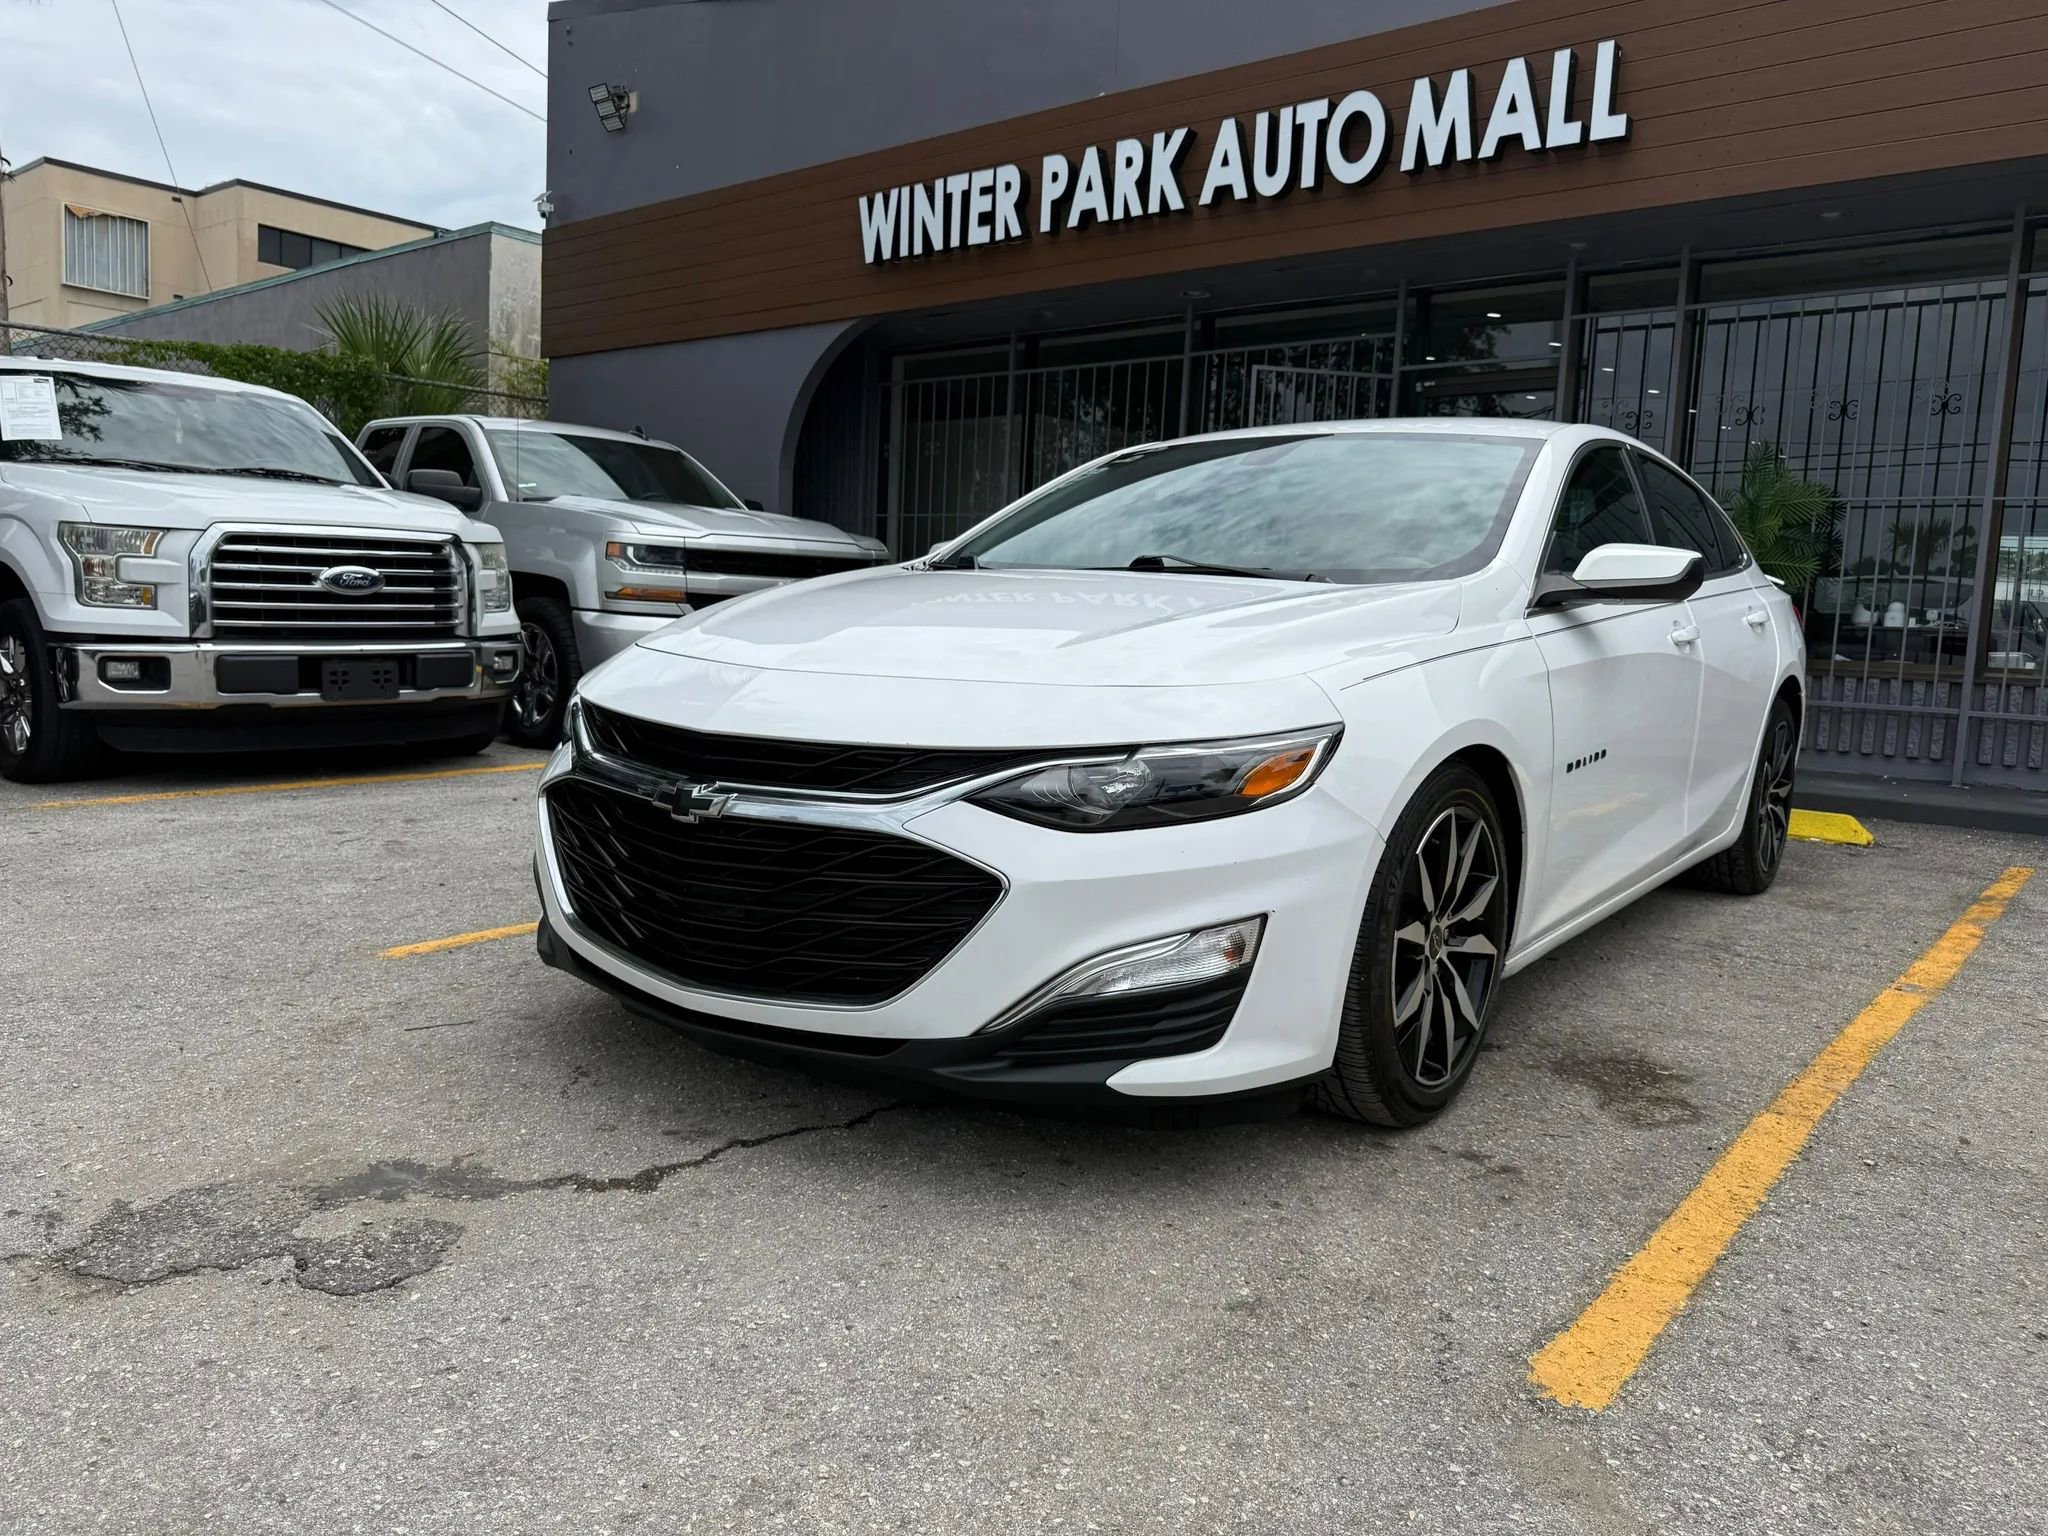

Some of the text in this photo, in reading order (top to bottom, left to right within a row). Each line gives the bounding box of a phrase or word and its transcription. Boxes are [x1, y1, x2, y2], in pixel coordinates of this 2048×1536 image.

[859, 39, 1628, 264] WINTER PARK AUTO MALL
[340, 572, 372, 586] Ford
